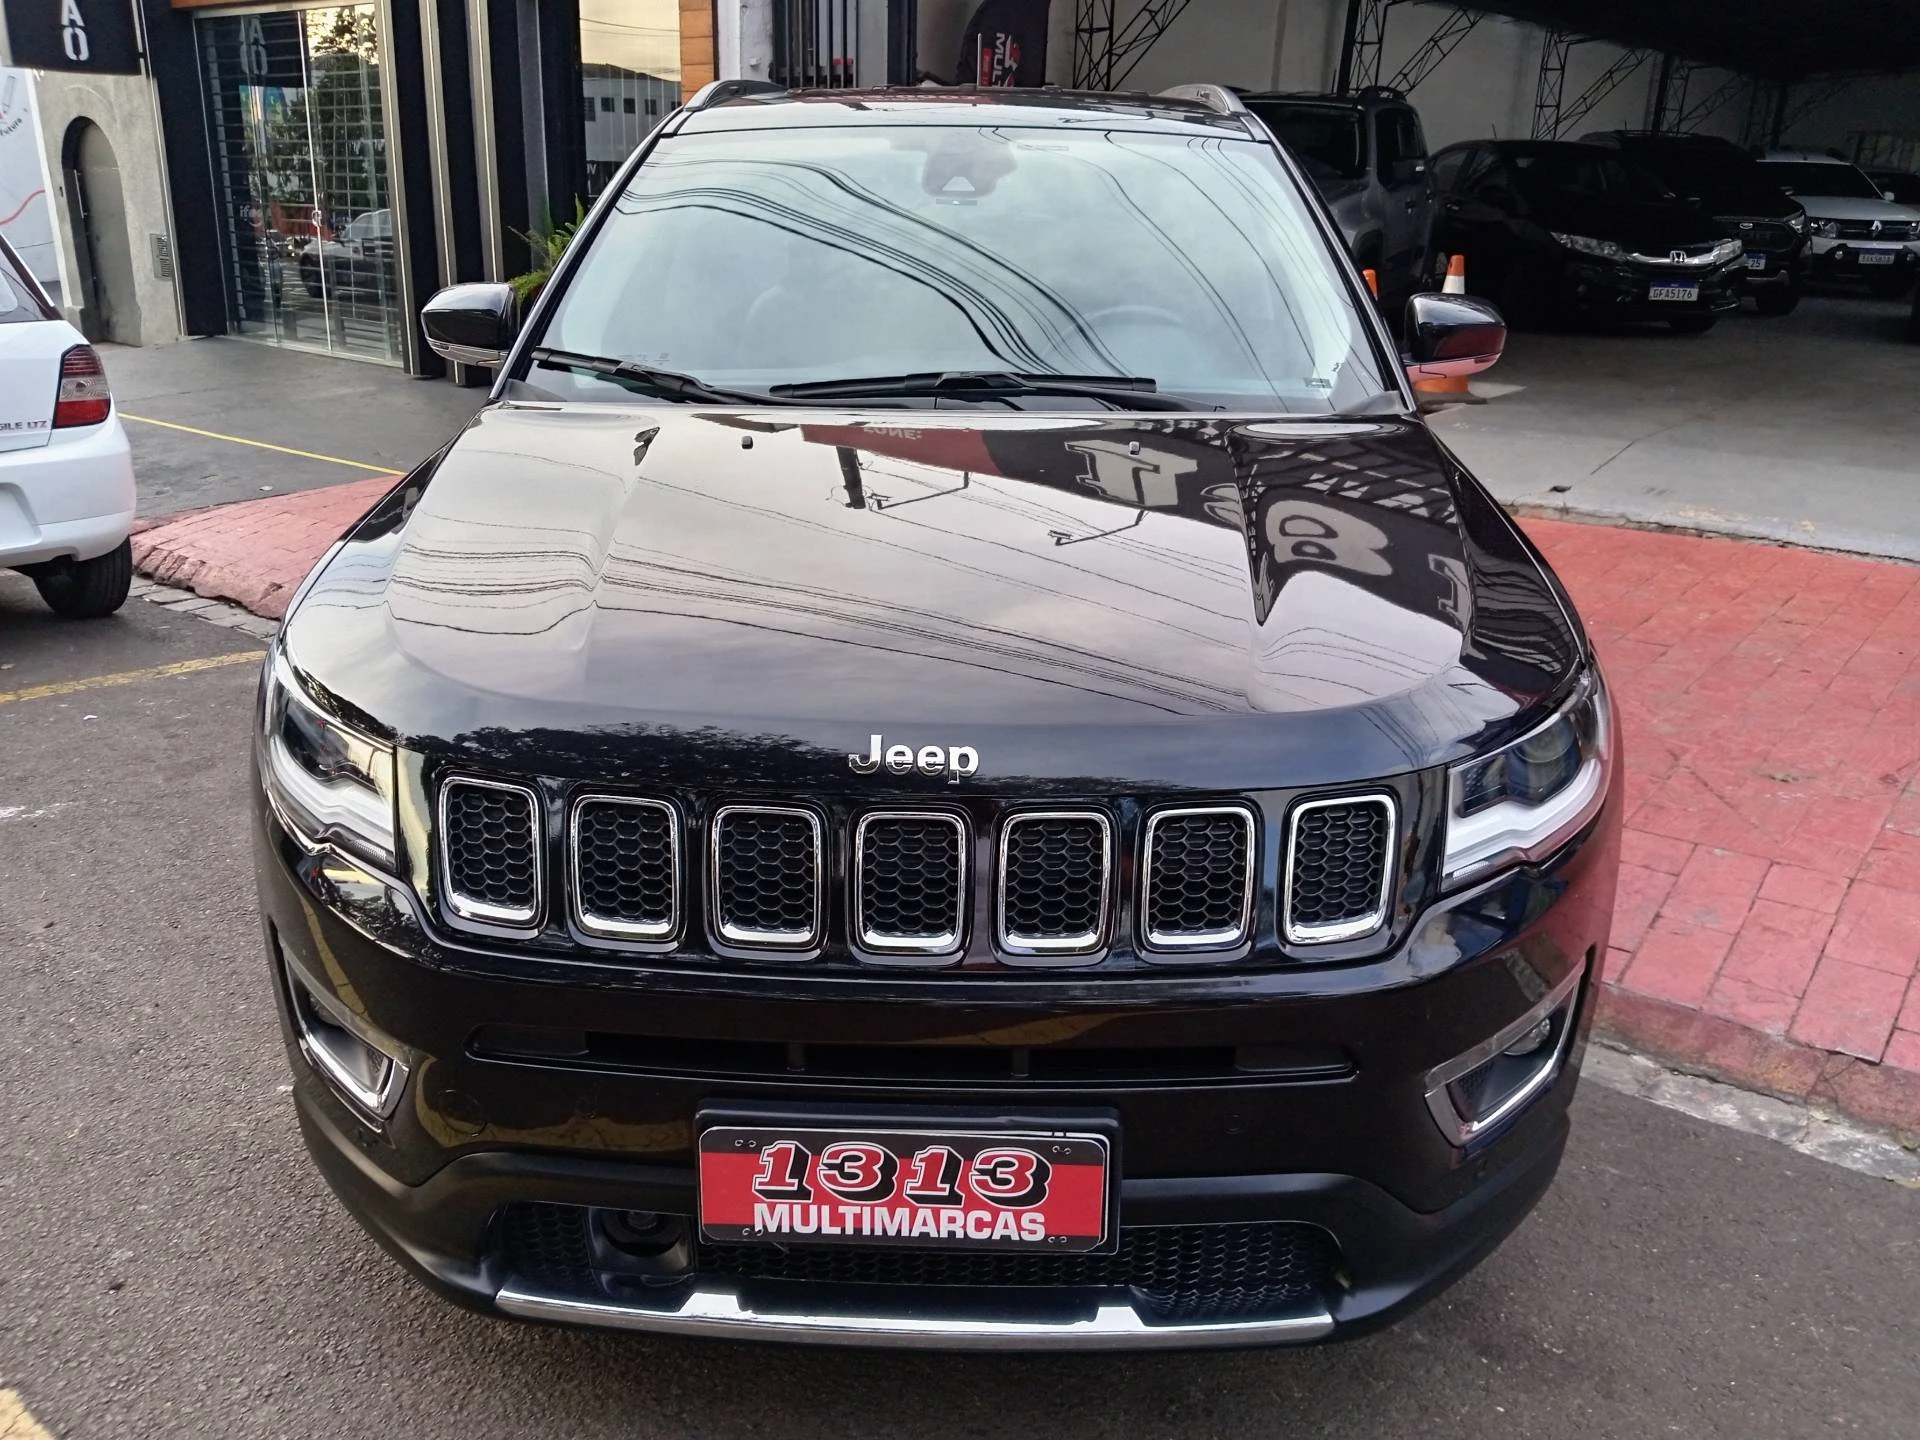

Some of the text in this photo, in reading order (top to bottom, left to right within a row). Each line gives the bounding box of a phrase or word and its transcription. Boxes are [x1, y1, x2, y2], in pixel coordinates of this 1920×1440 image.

[848, 734, 979, 784] Jeep
[752, 1140, 1053, 1209] 1313
[753, 1203, 1046, 1241] MULTIMARCAS
